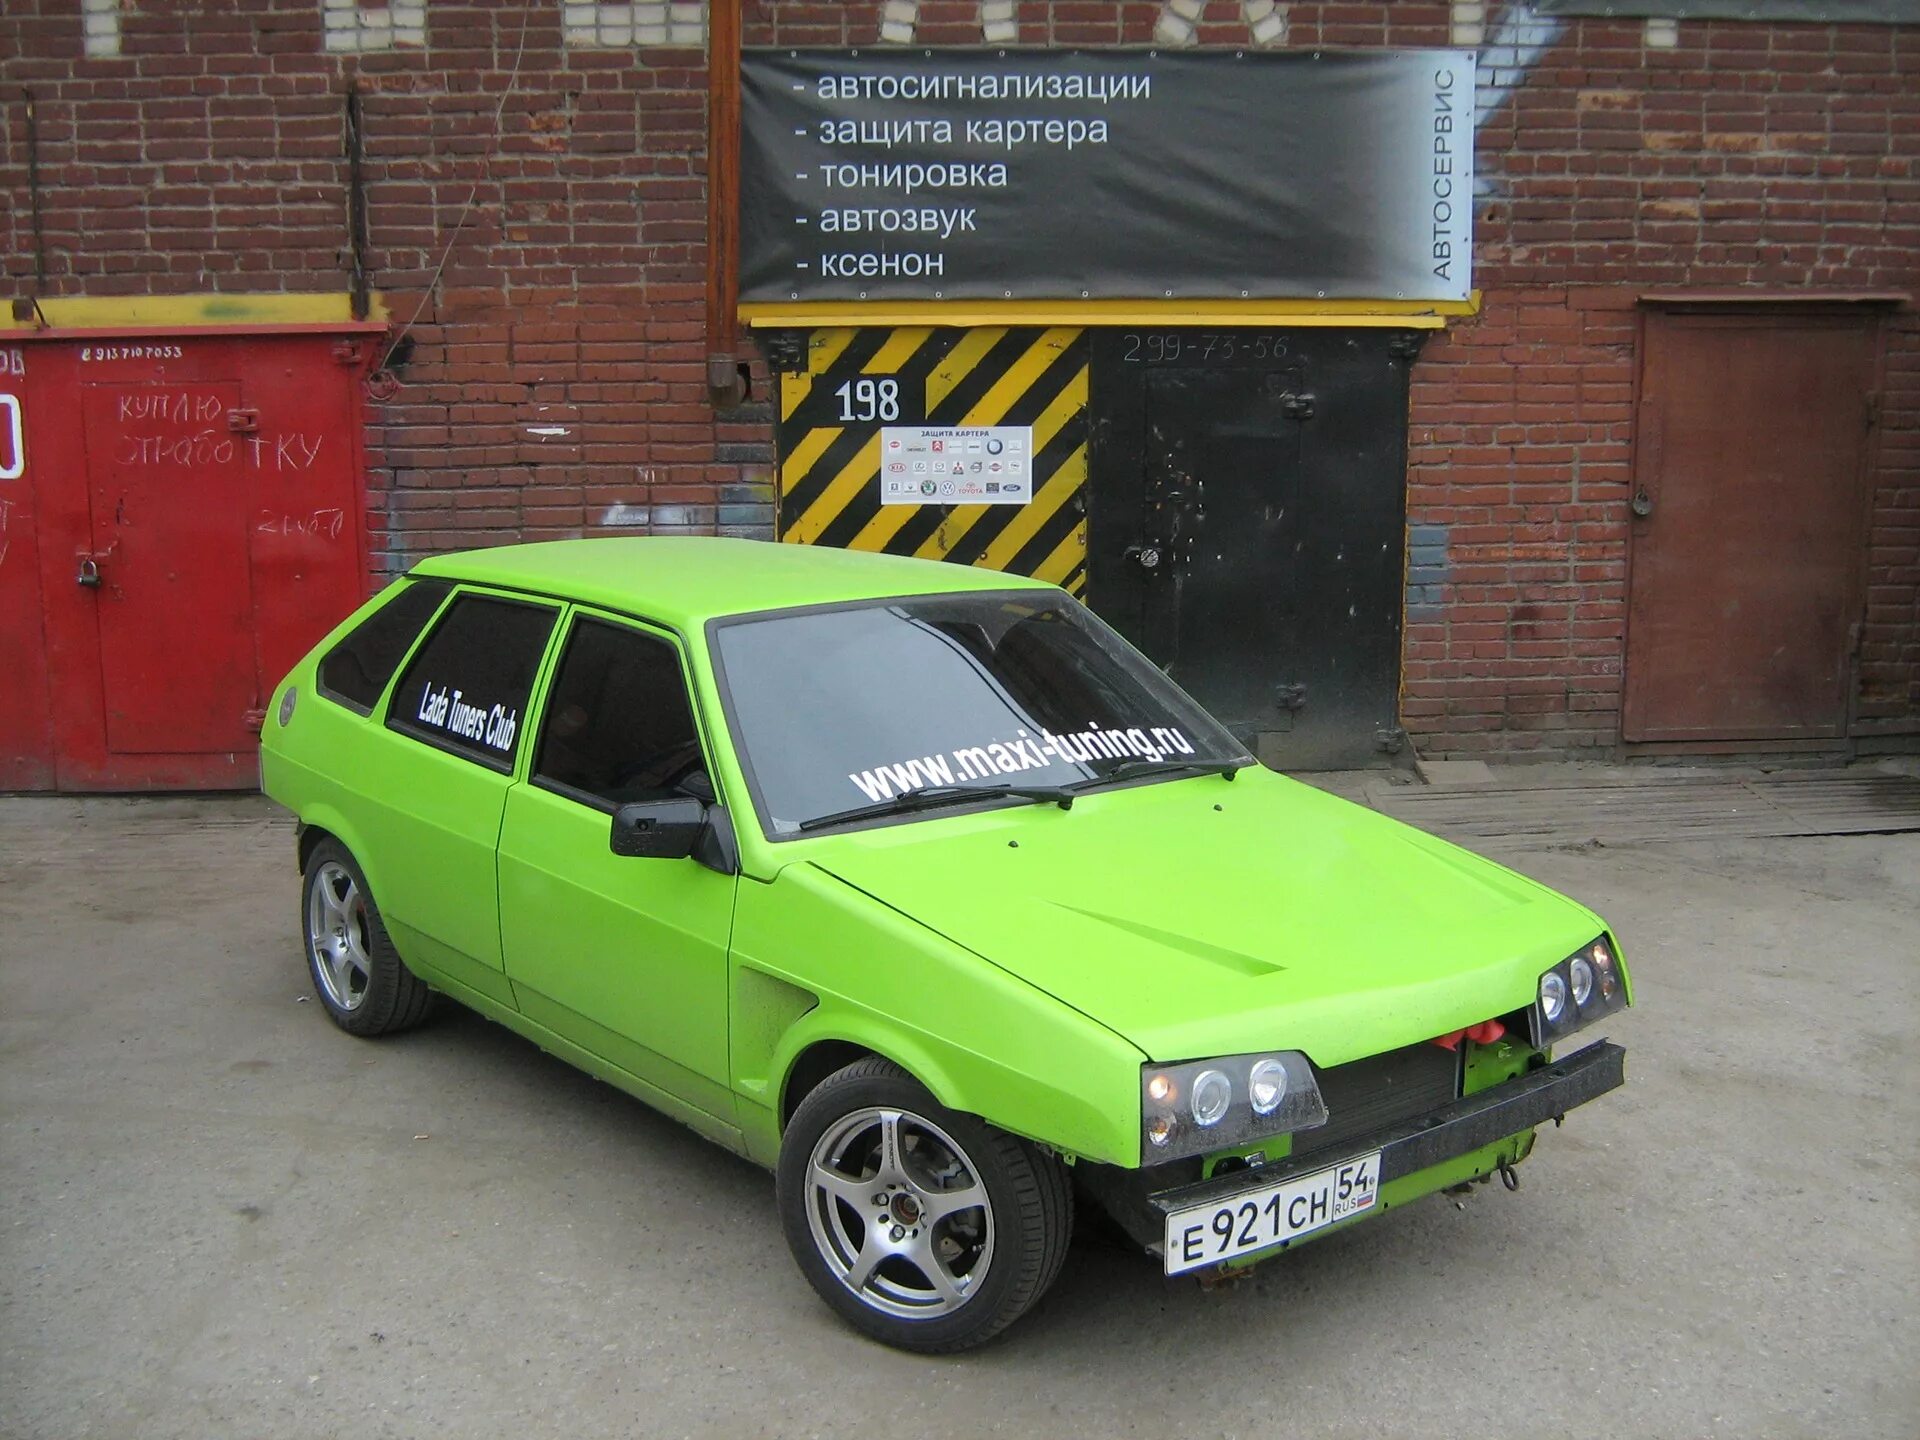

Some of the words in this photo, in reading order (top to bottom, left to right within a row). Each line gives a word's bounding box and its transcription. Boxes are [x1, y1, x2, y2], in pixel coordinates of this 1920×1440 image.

[817, 75, 1151, 104] автосигнализации
[819, 120, 952, 148] защита
[966, 118, 1109, 150] картера
[820, 163, 1008, 194] тонировка
[1433, 69, 1454, 281] АВТОСЕРВИС
[820, 208, 976, 239] автозвук
[821, 252, 944, 276] ксенон
[1124, 334, 1289, 361] 299-73-56
[834, 379, 900, 421] 198
[921, 430, 954, 438] ЗАЩИТА
[955, 430, 990, 438] КАРТЕРА
[418, 681, 449, 727] Lada
[447, 689, 488, 741] Tuners
[486, 703, 517, 752] Club
[849, 721, 1196, 802] www.maxi-tuning.ru
[1334, 1199, 1357, 1216] RUS
